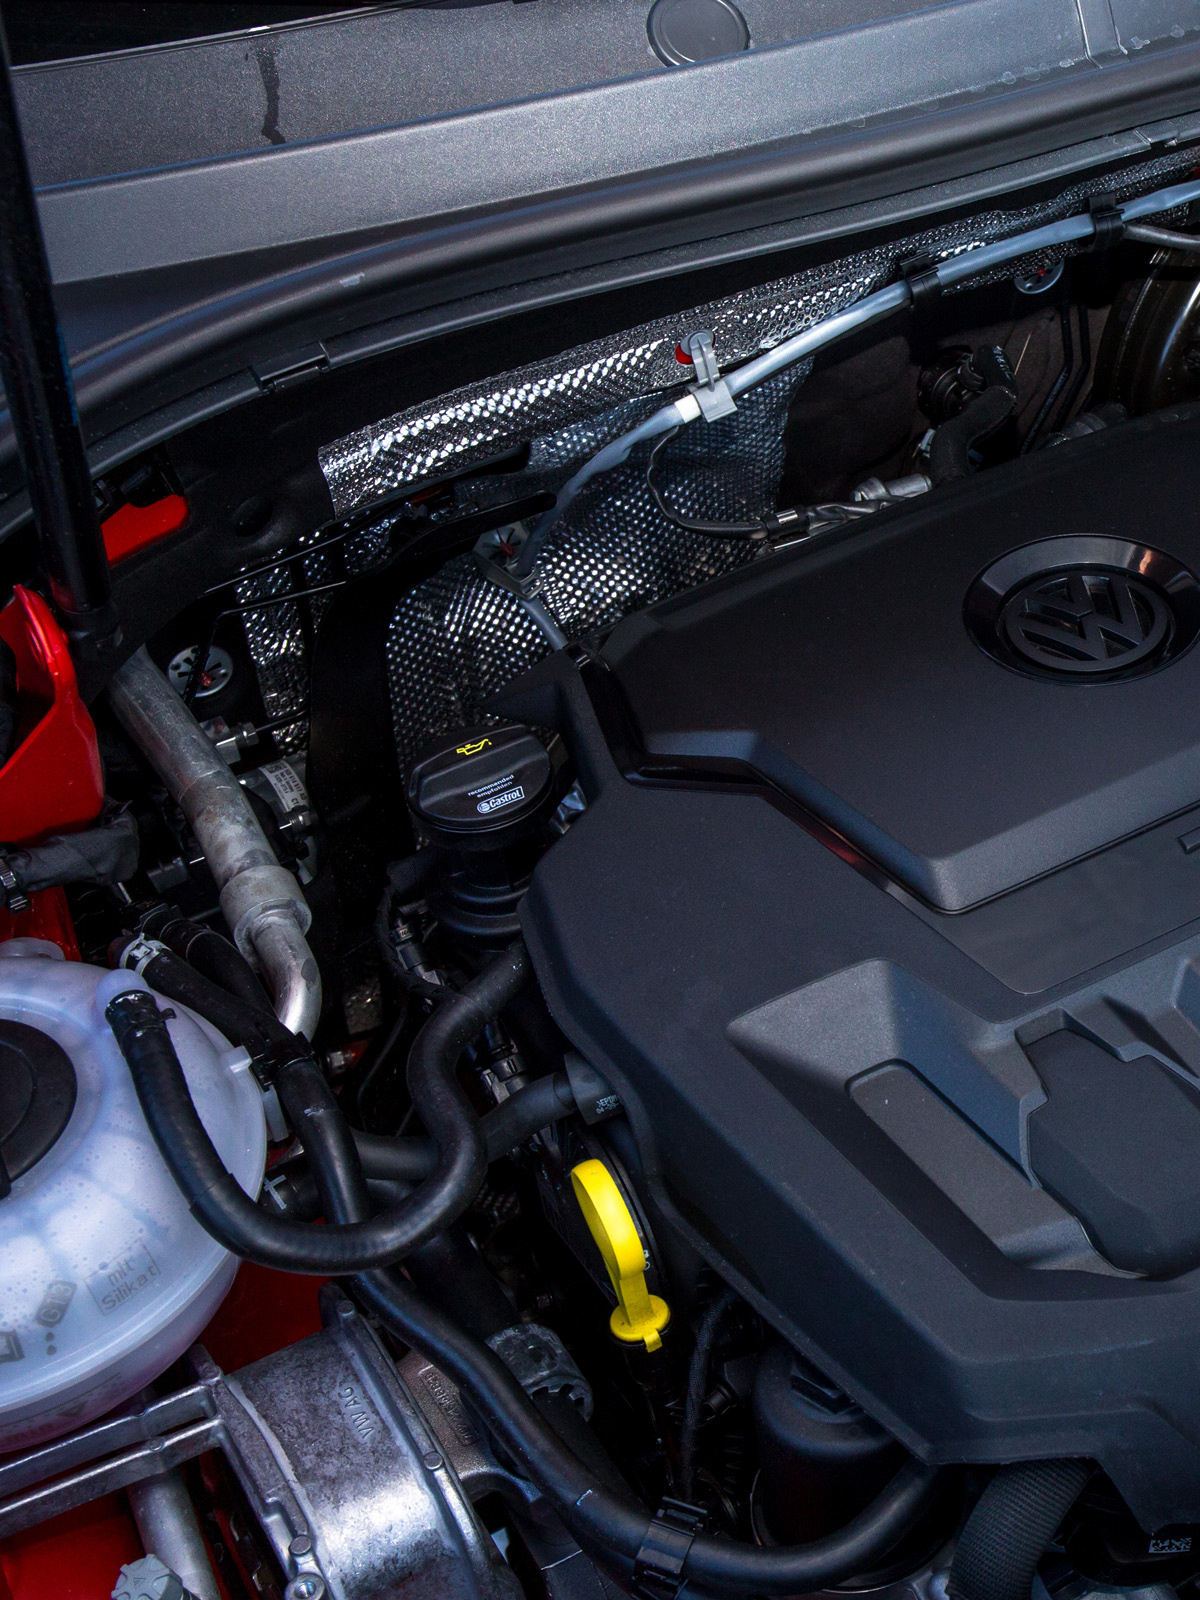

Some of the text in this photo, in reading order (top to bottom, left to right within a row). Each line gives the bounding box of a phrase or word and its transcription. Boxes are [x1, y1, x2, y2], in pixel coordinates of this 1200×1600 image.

[467, 774, 515, 797] recommended
[476, 781, 513, 798] empfohlen
[489, 788, 522, 808] Castrol
[107, 1259, 136, 1287] mit
[102, 1264, 158, 1311] Silikat
[337, 1385, 376, 1440] VW AG
